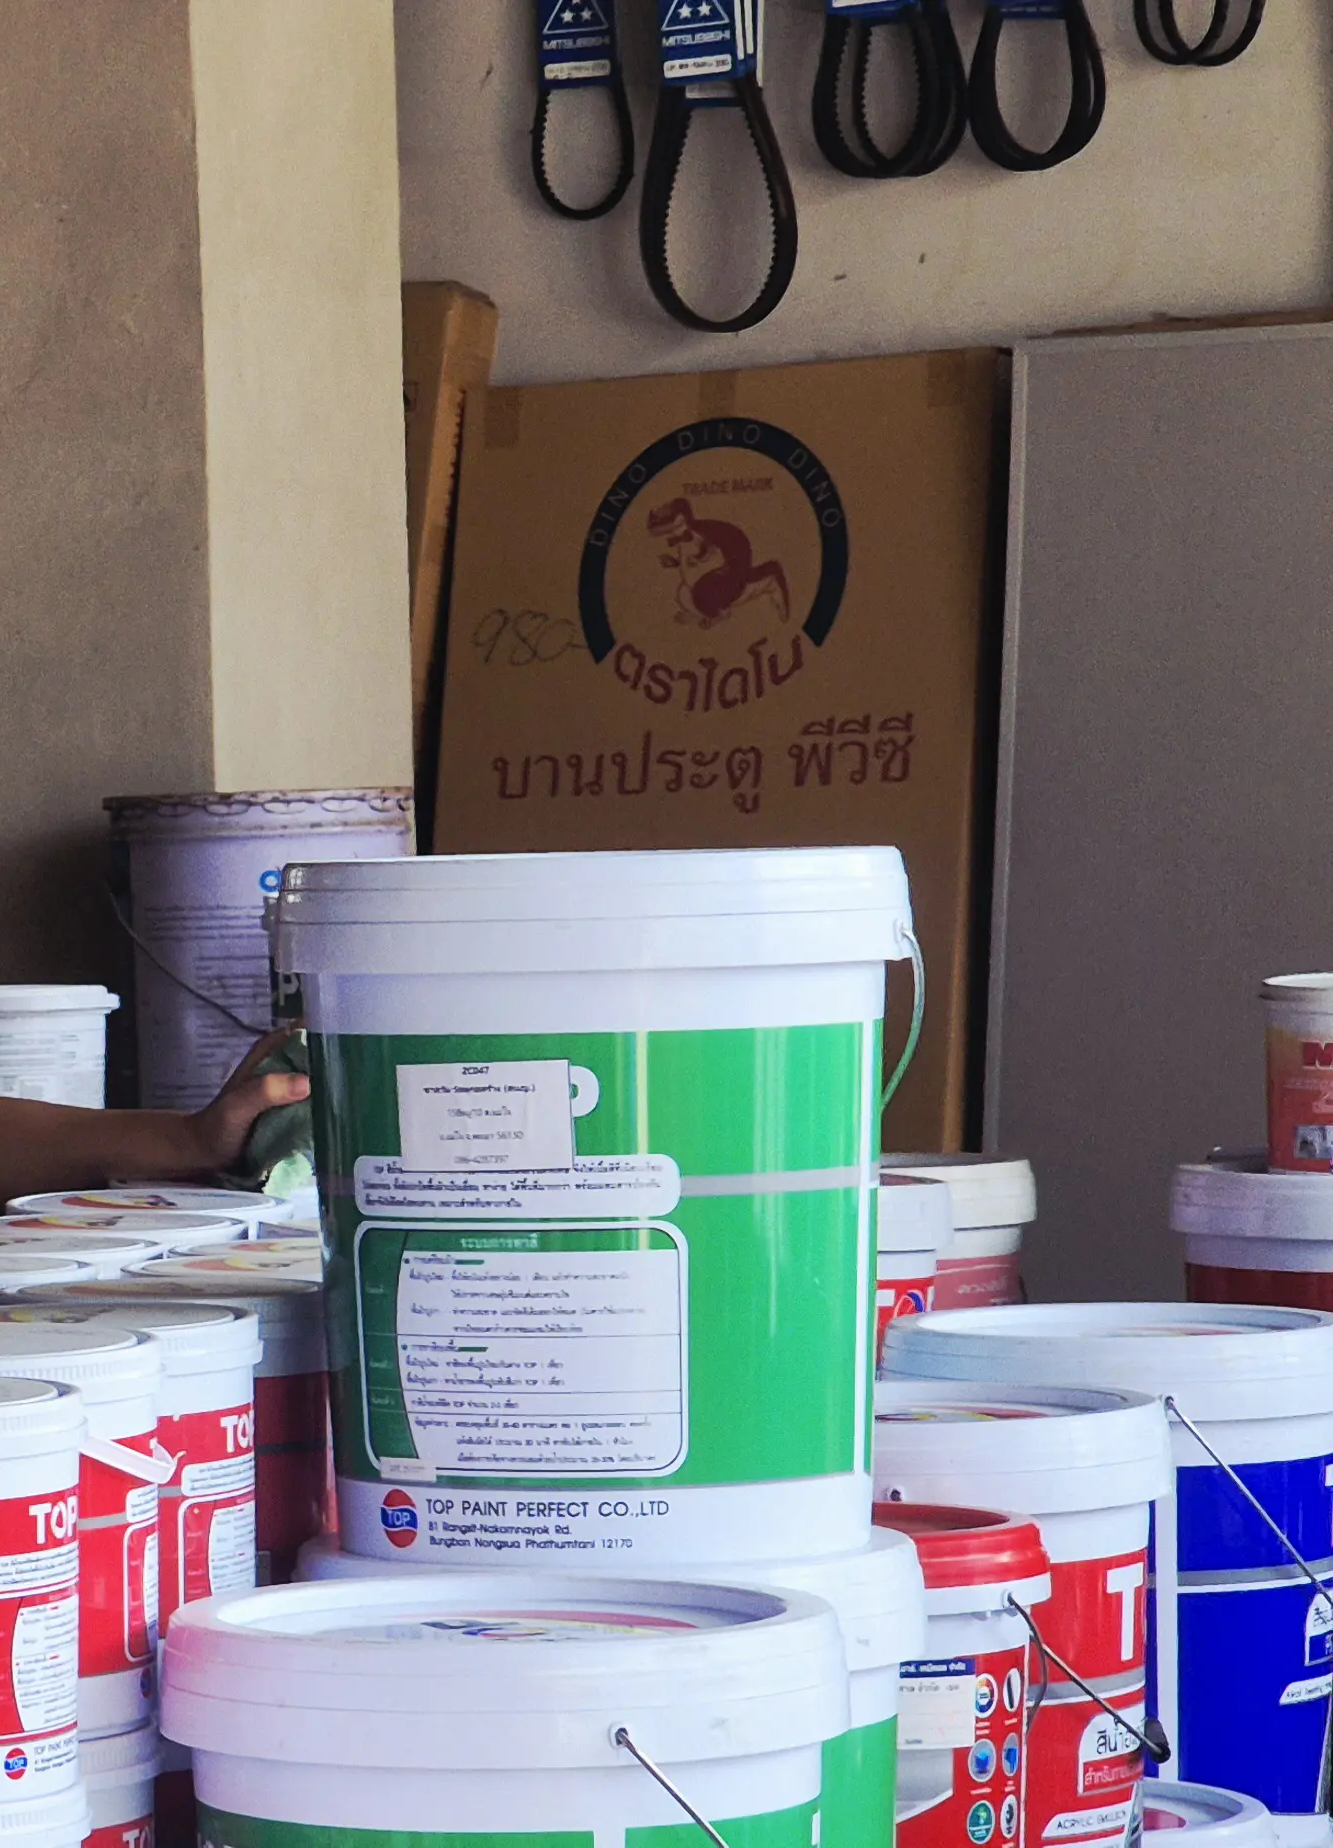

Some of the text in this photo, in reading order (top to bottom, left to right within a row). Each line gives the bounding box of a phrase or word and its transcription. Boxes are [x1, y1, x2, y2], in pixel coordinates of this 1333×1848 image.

[589, 421, 842, 547] DINO DINO DINO
[614, 634, 805, 713] ตราไดโน
[492, 712, 915, 815] บานประตู พีวีซี
[29, 1495, 77, 1545] TOP
[386, 1510, 412, 1527] TOP
[426, 1498, 670, 1518] TOP PAINT PERFECT CO.,LTD
